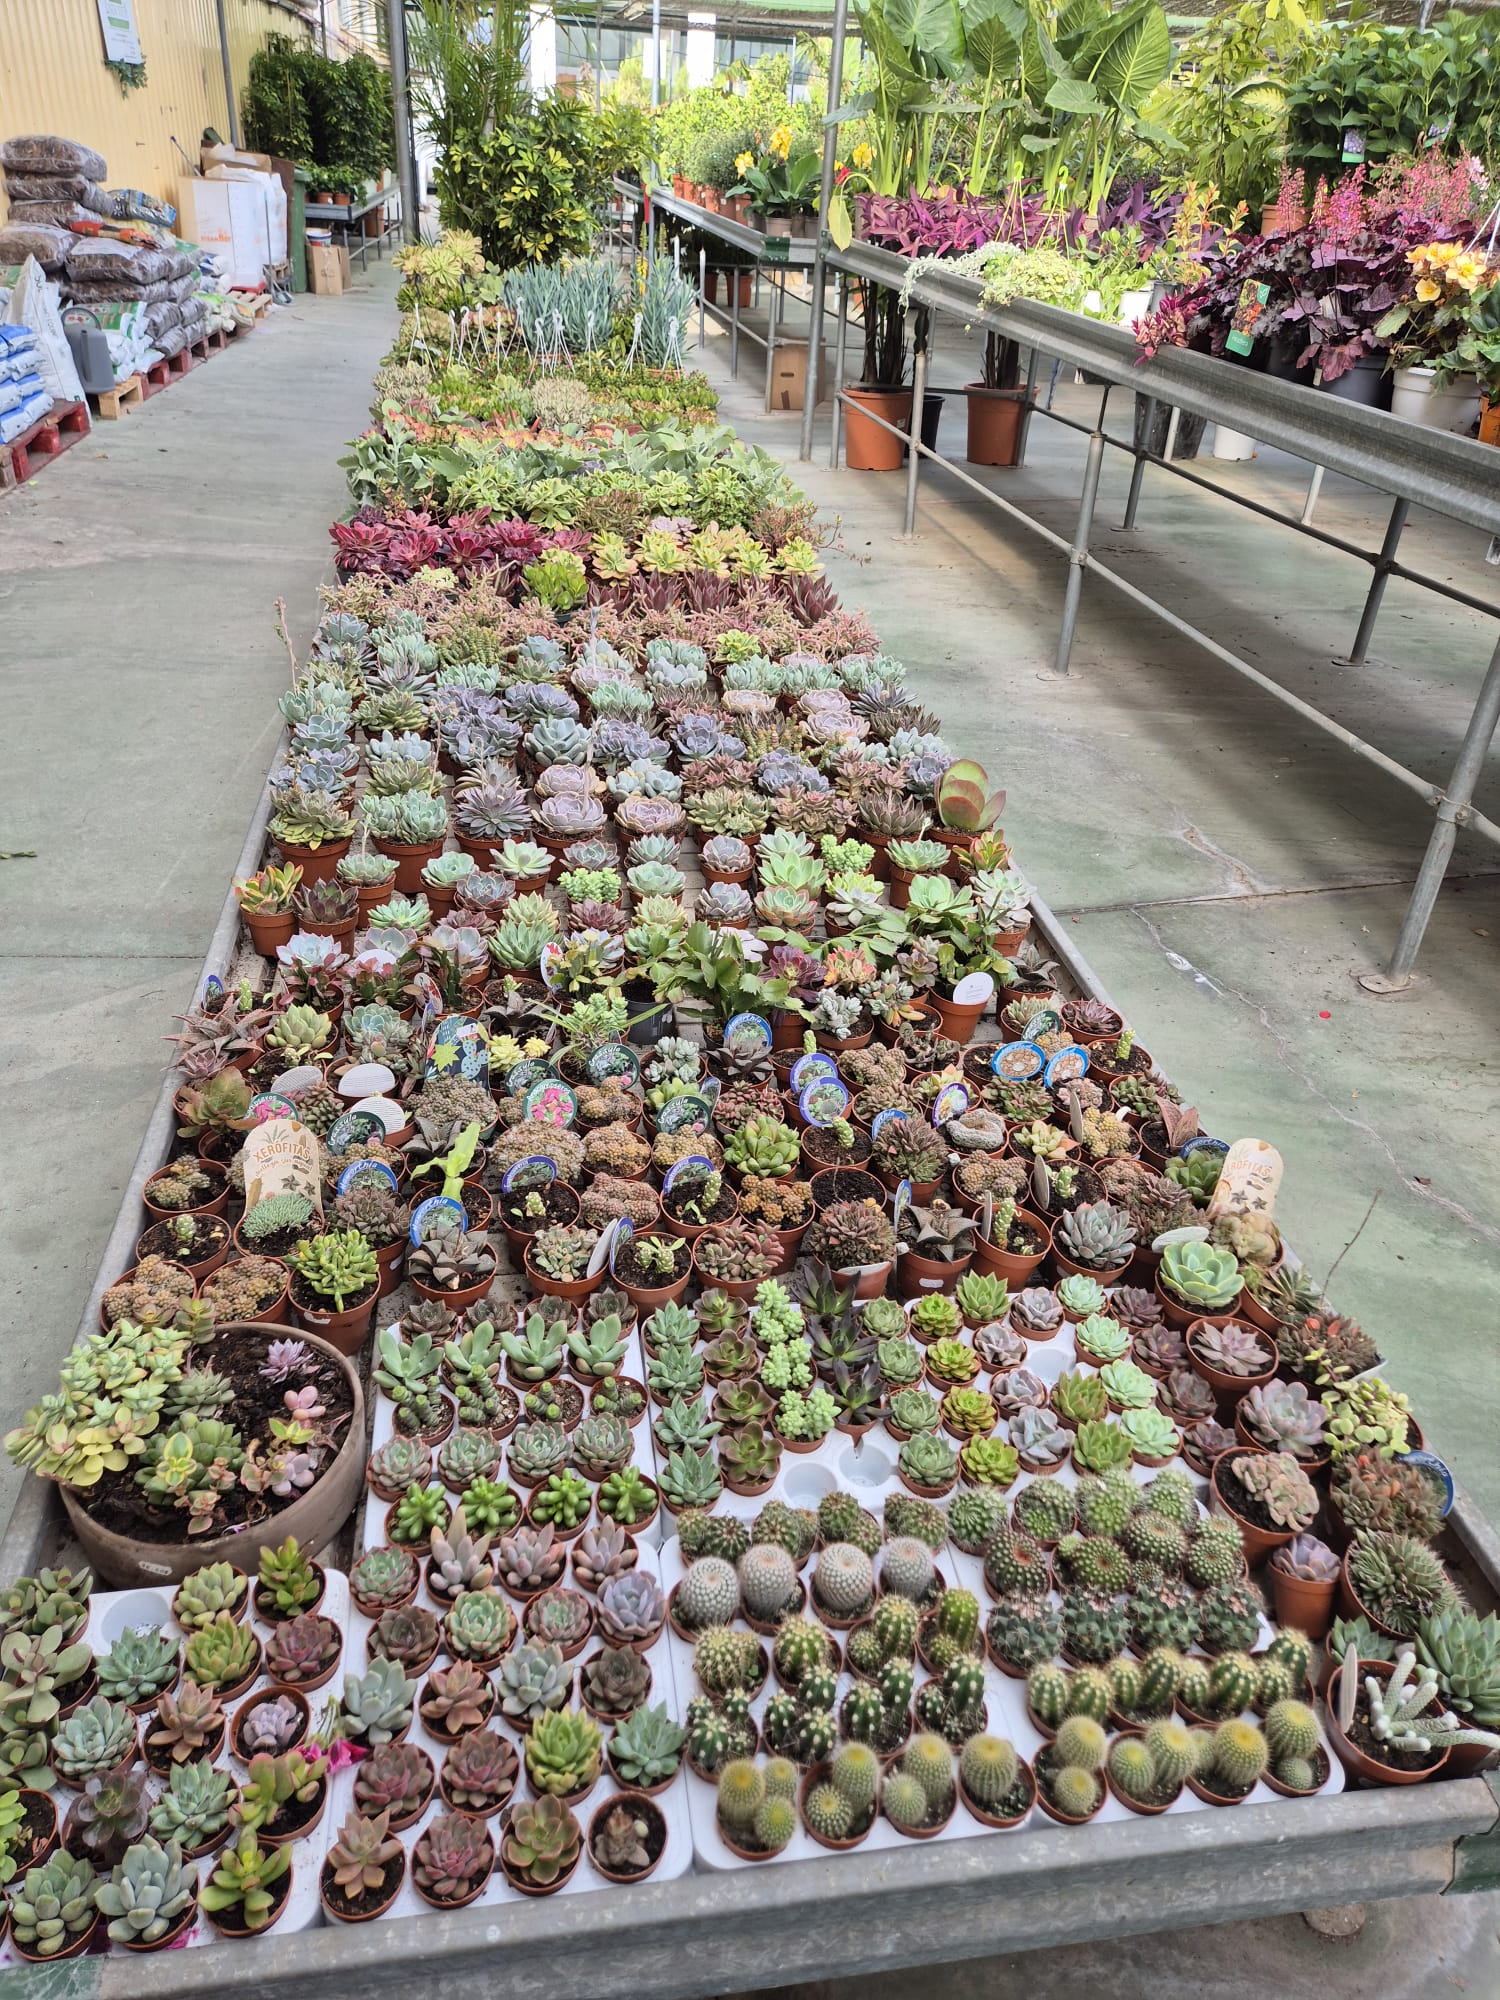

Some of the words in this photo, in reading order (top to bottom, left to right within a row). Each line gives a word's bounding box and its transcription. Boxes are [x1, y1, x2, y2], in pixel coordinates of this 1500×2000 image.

[588, 1046, 621, 1067] Crassula
[506, 1060, 535, 1087] Crassula
[657, 1096, 690, 1124] Crassula
[327, 1113, 357, 1146] Crassula
